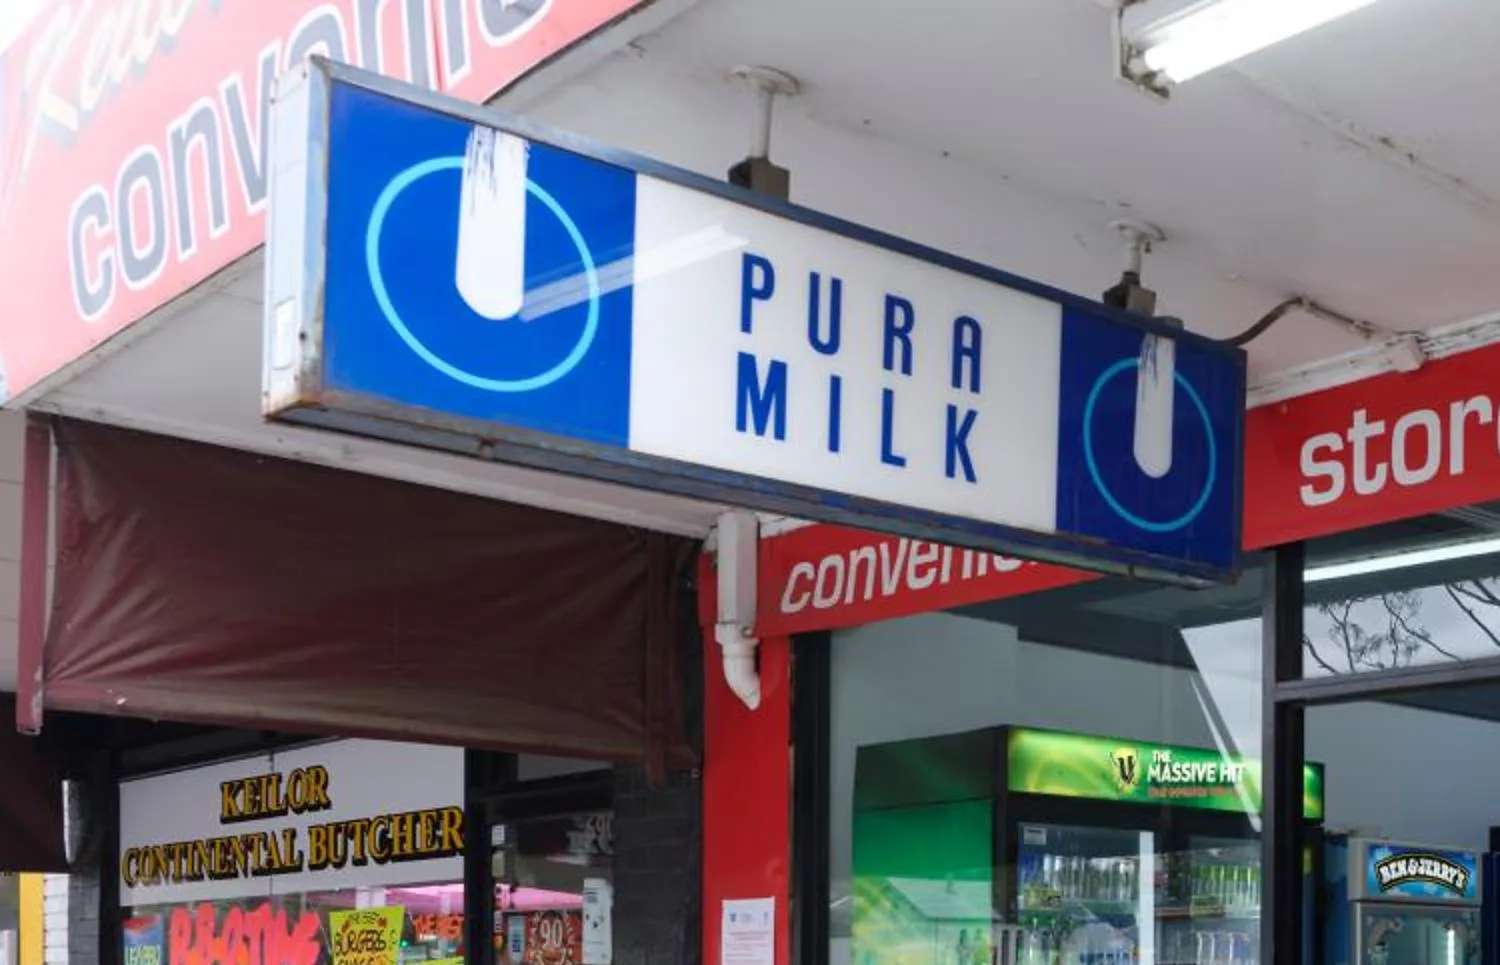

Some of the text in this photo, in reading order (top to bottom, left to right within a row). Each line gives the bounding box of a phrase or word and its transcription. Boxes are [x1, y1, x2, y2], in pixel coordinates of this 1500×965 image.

[740, 252, 982, 394] PURA
[735, 351, 978, 484] MILK
[1147, 761, 1246, 783] MASSIVE HIT
[1151, 749, 1172, 763] THE
[220, 765, 331, 825] KEILOR
[121, 805, 465, 888] CONTINENTAL BUTCHER
